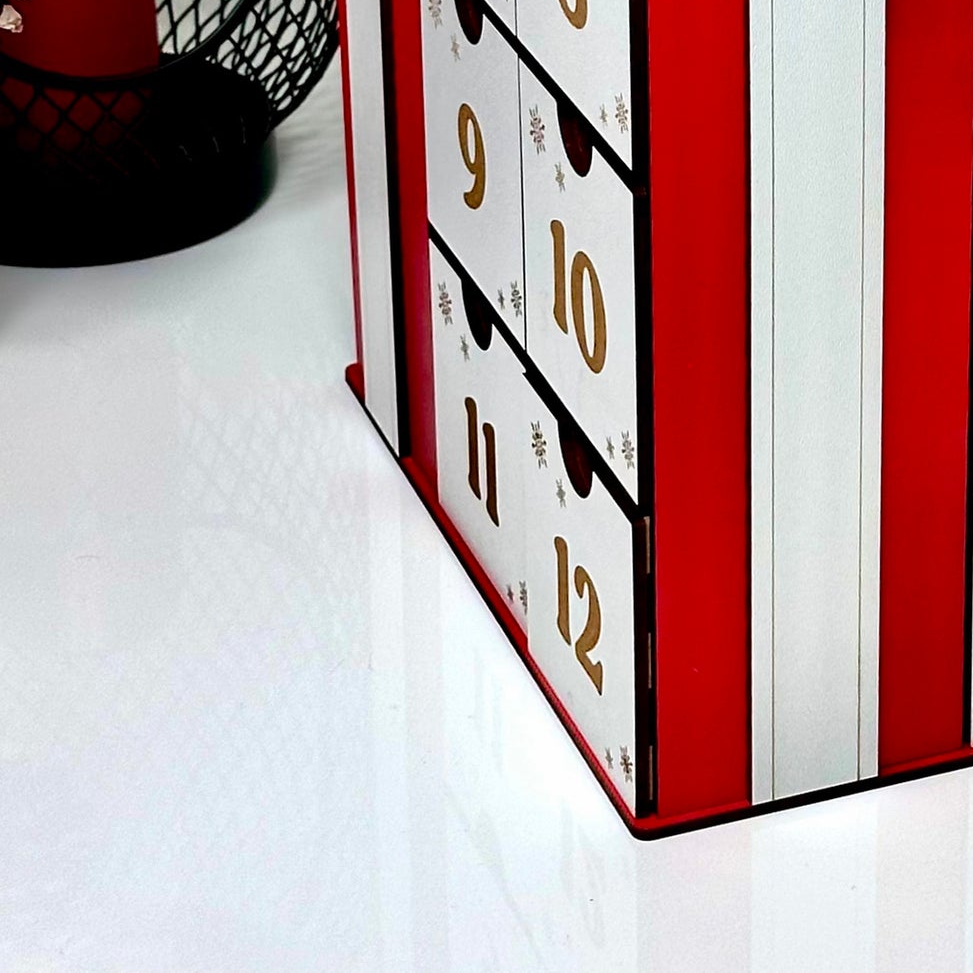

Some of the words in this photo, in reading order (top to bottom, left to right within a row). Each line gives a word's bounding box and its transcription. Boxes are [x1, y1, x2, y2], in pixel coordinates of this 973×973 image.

[458, 103, 485, 210] 9
[550, 220, 606, 374] 10
[465, 397, 499, 527] 11
[554, 536, 603, 696] 12
